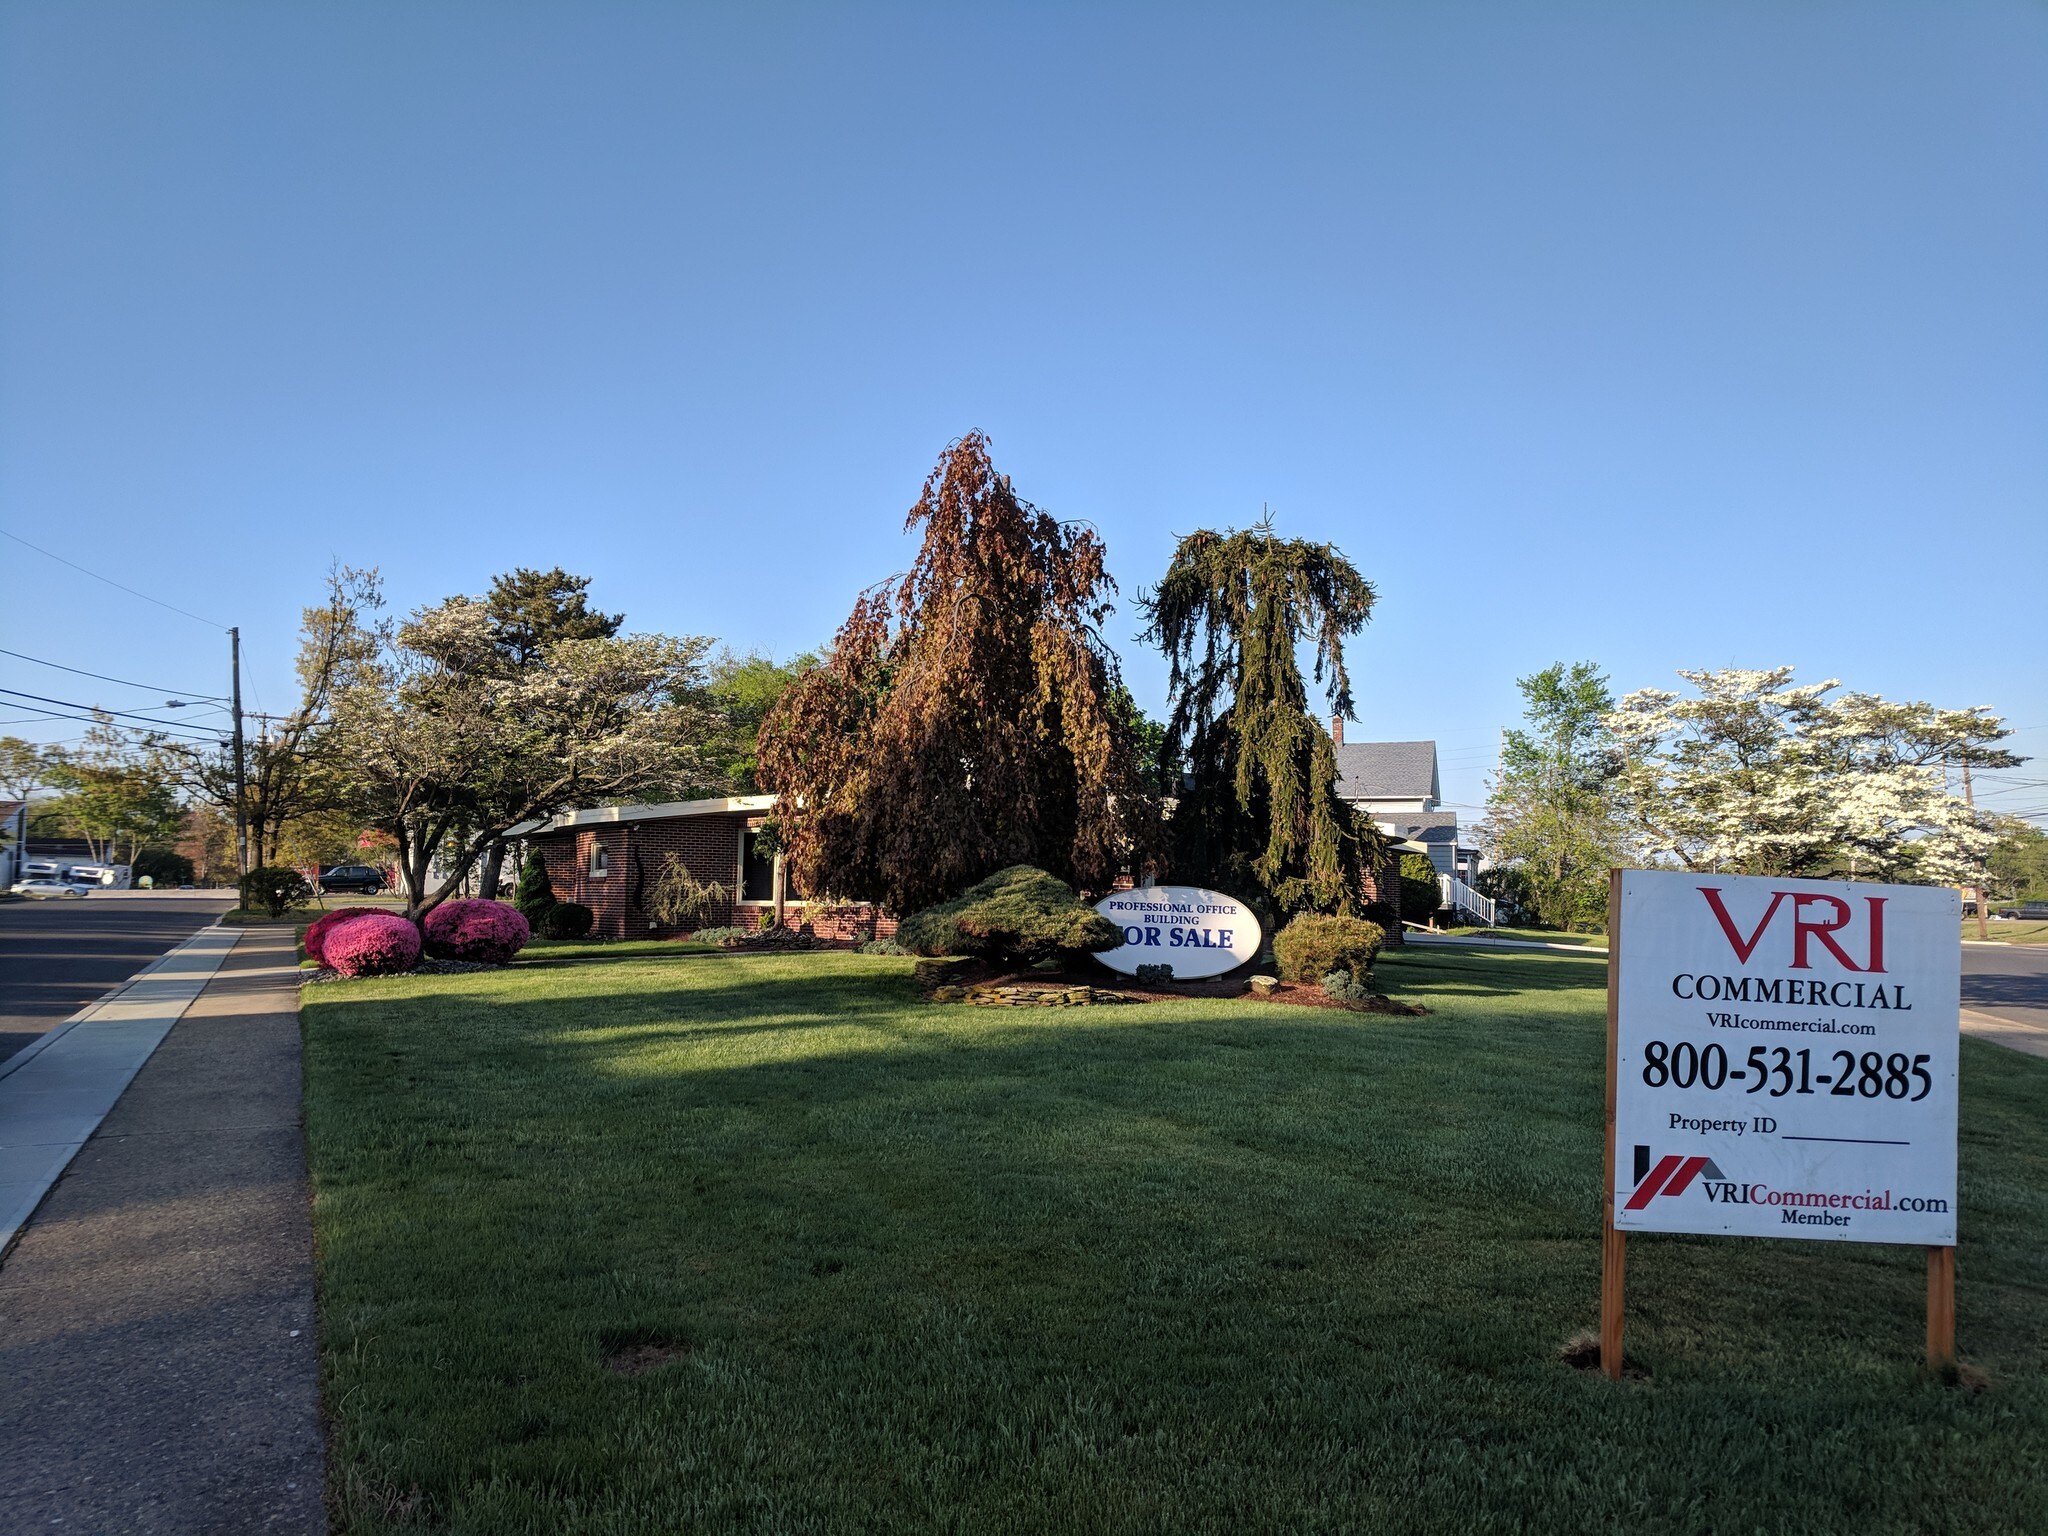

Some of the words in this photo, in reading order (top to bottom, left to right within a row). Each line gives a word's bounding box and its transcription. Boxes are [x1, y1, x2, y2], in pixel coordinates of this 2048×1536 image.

[1109, 901, 1194, 913] PROFESSIONAL
[1196, 905, 1237, 915] OFFICE
[1144, 914, 1200, 925] BUILDING
[1116, 926, 1161, 946] OR
[1170, 928, 1233, 949] SALE
[1696, 887, 1889, 974] VRI
[1672, 973, 1912, 1010] COMMERCIAL
[1707, 1012, 1876, 1036] VRIcommercial.com
[1642, 1040, 1932, 1102] 800-531-2885
[1669, 1113, 1748, 1135] Property
[1752, 1116, 1777, 1134] ID
[1702, 1182, 1948, 1213] VRICommercial.com
[1781, 1209, 1851, 1227] Member
